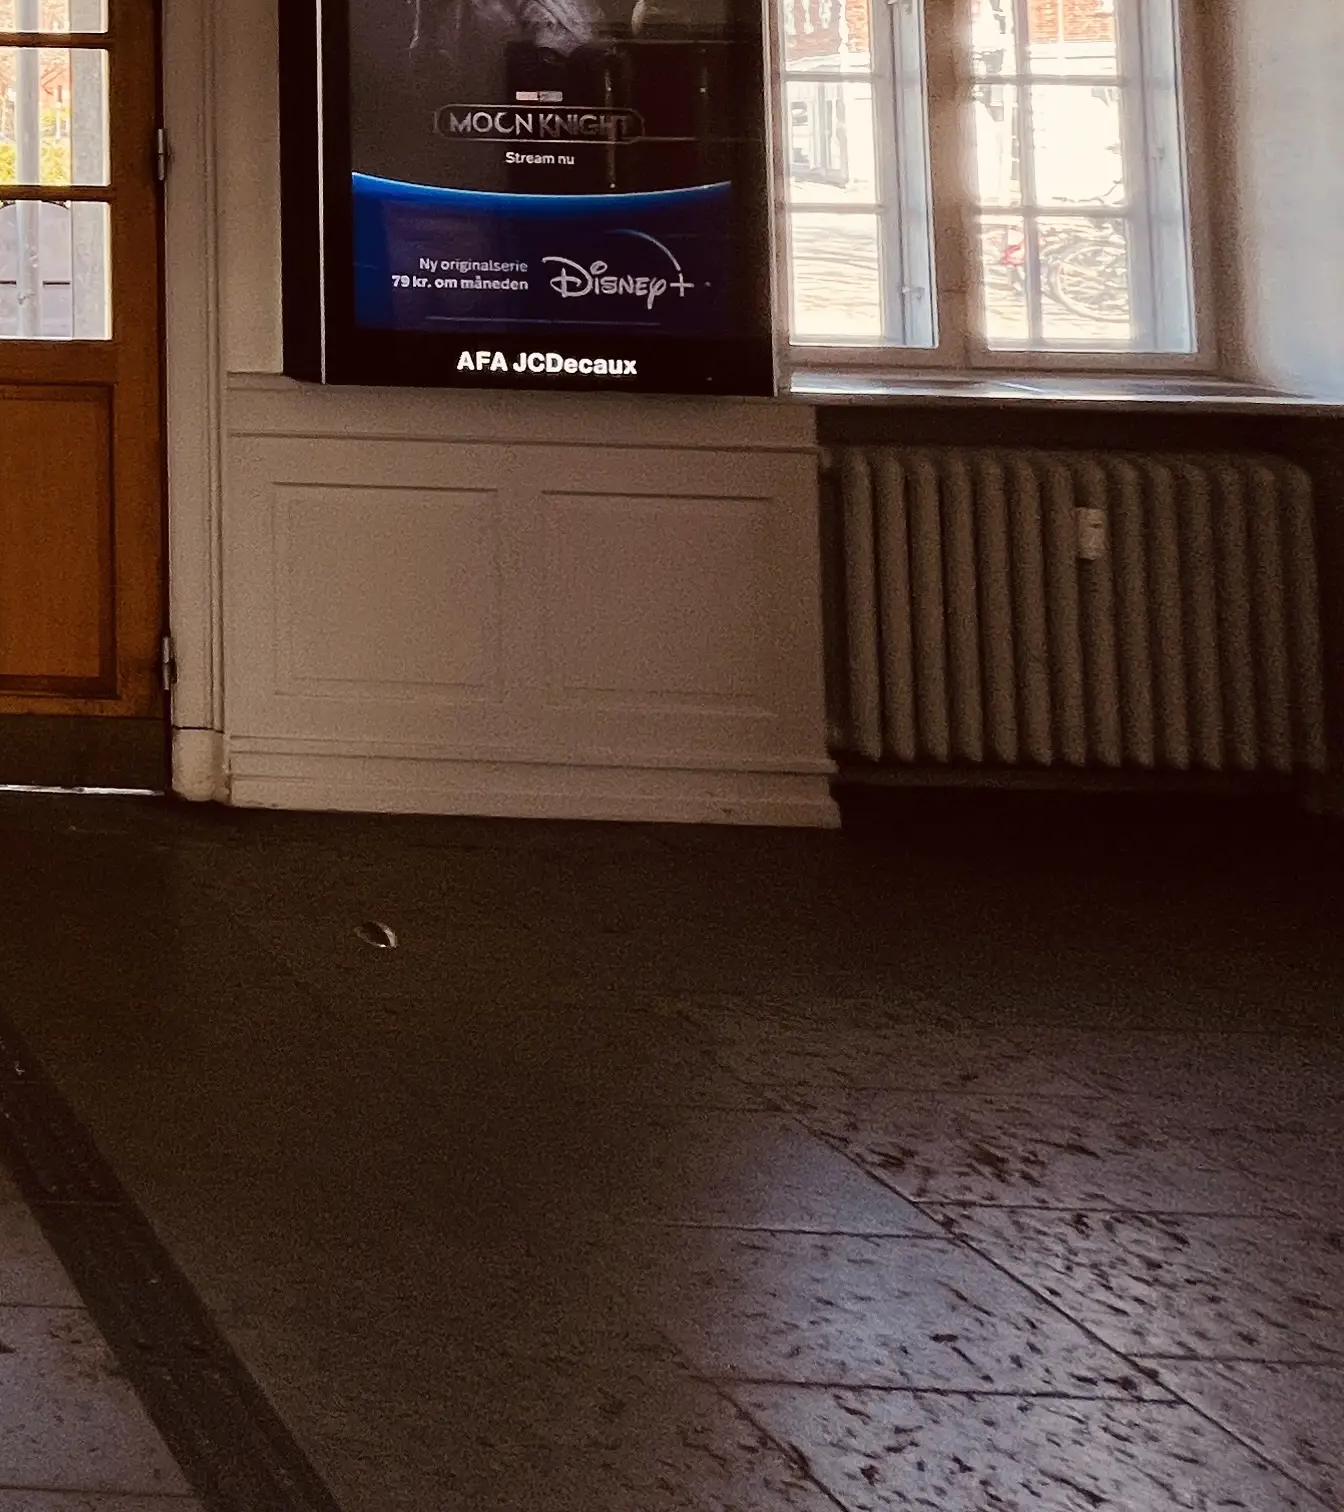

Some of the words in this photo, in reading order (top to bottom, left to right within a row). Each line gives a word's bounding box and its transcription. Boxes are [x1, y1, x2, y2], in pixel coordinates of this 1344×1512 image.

[449, 111, 533, 136] MOON
[539, 113, 628, 138] KNIGHT
[505, 151, 555, 165] Stream
[558, 155, 575, 165] nu
[419, 257, 437, 273] Ny
[440, 258, 528, 273] originalserie
[392, 275, 410, 288] 79
[412, 276, 432, 289] kr.
[434, 277, 458, 289] om
[460, 275, 529, 290] måneden
[456, 351, 509, 372] AFA
[513, 352, 637, 375] JCDecaux
